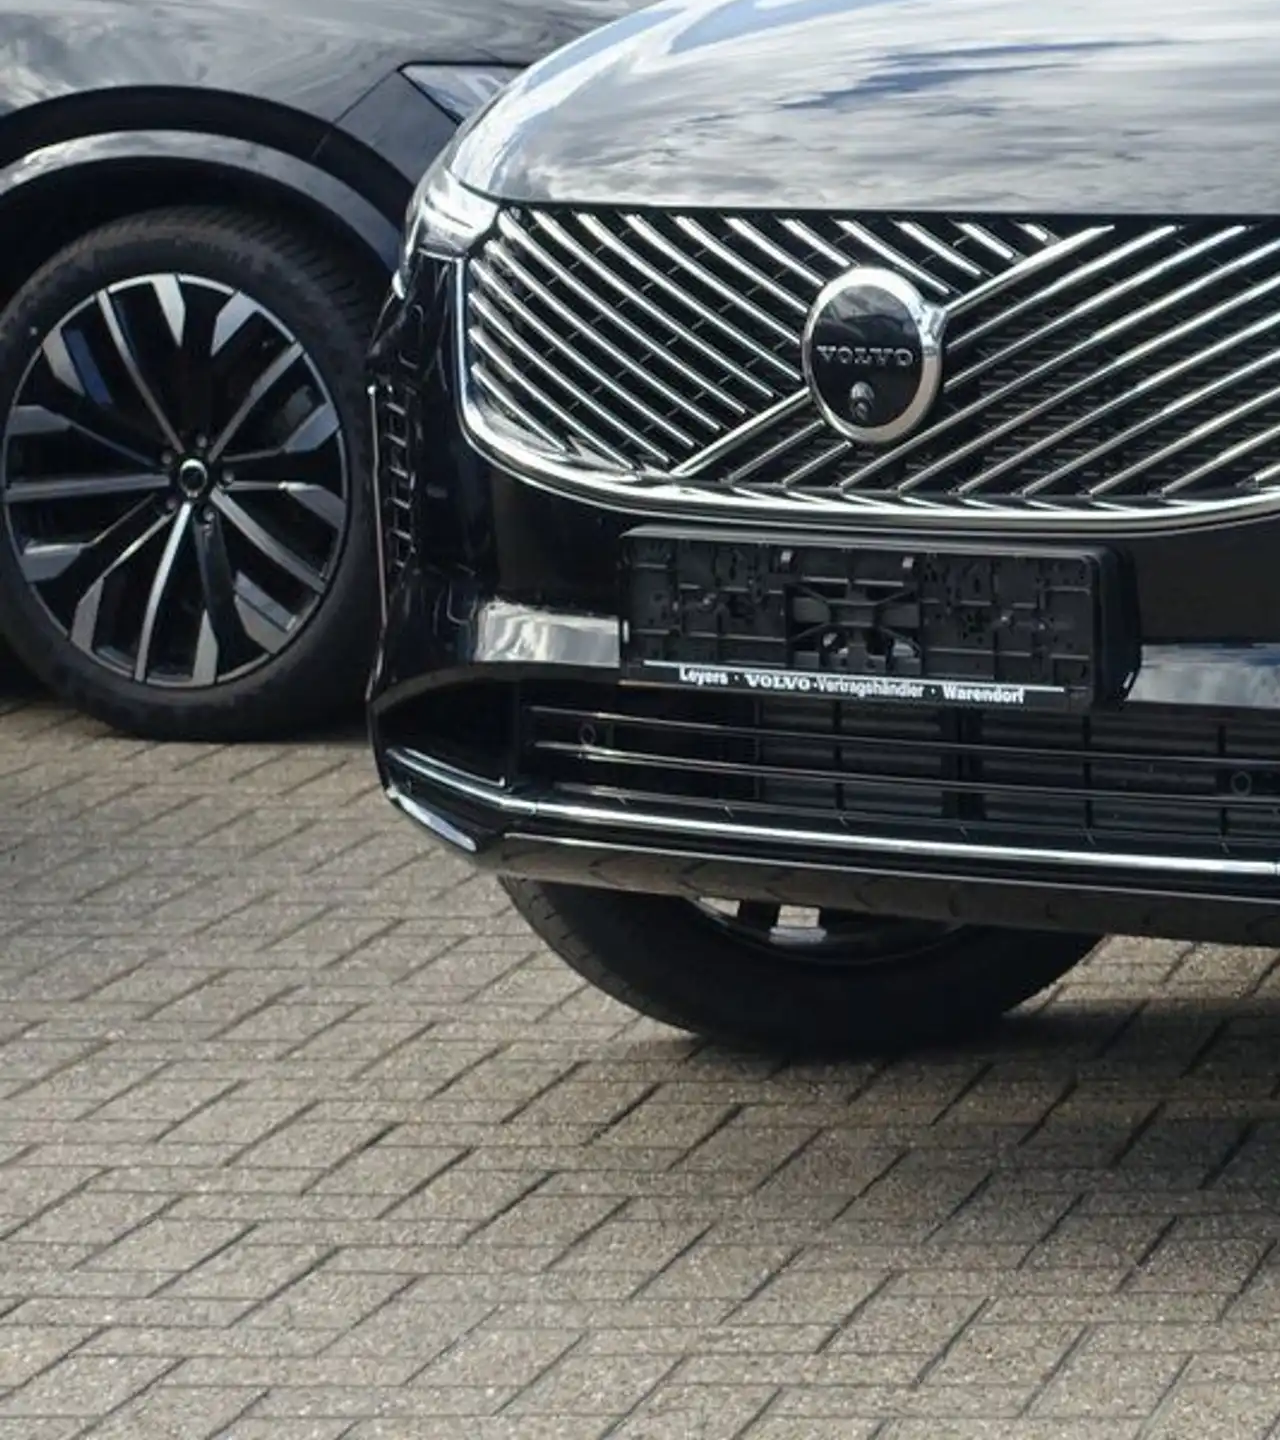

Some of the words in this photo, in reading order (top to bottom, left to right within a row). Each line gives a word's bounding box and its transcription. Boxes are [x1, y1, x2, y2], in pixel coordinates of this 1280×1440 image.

[816, 345, 914, 367] VOLVO
[678, 664, 729, 686] Leyers
[942, 684, 1025, 704] Warendorf
